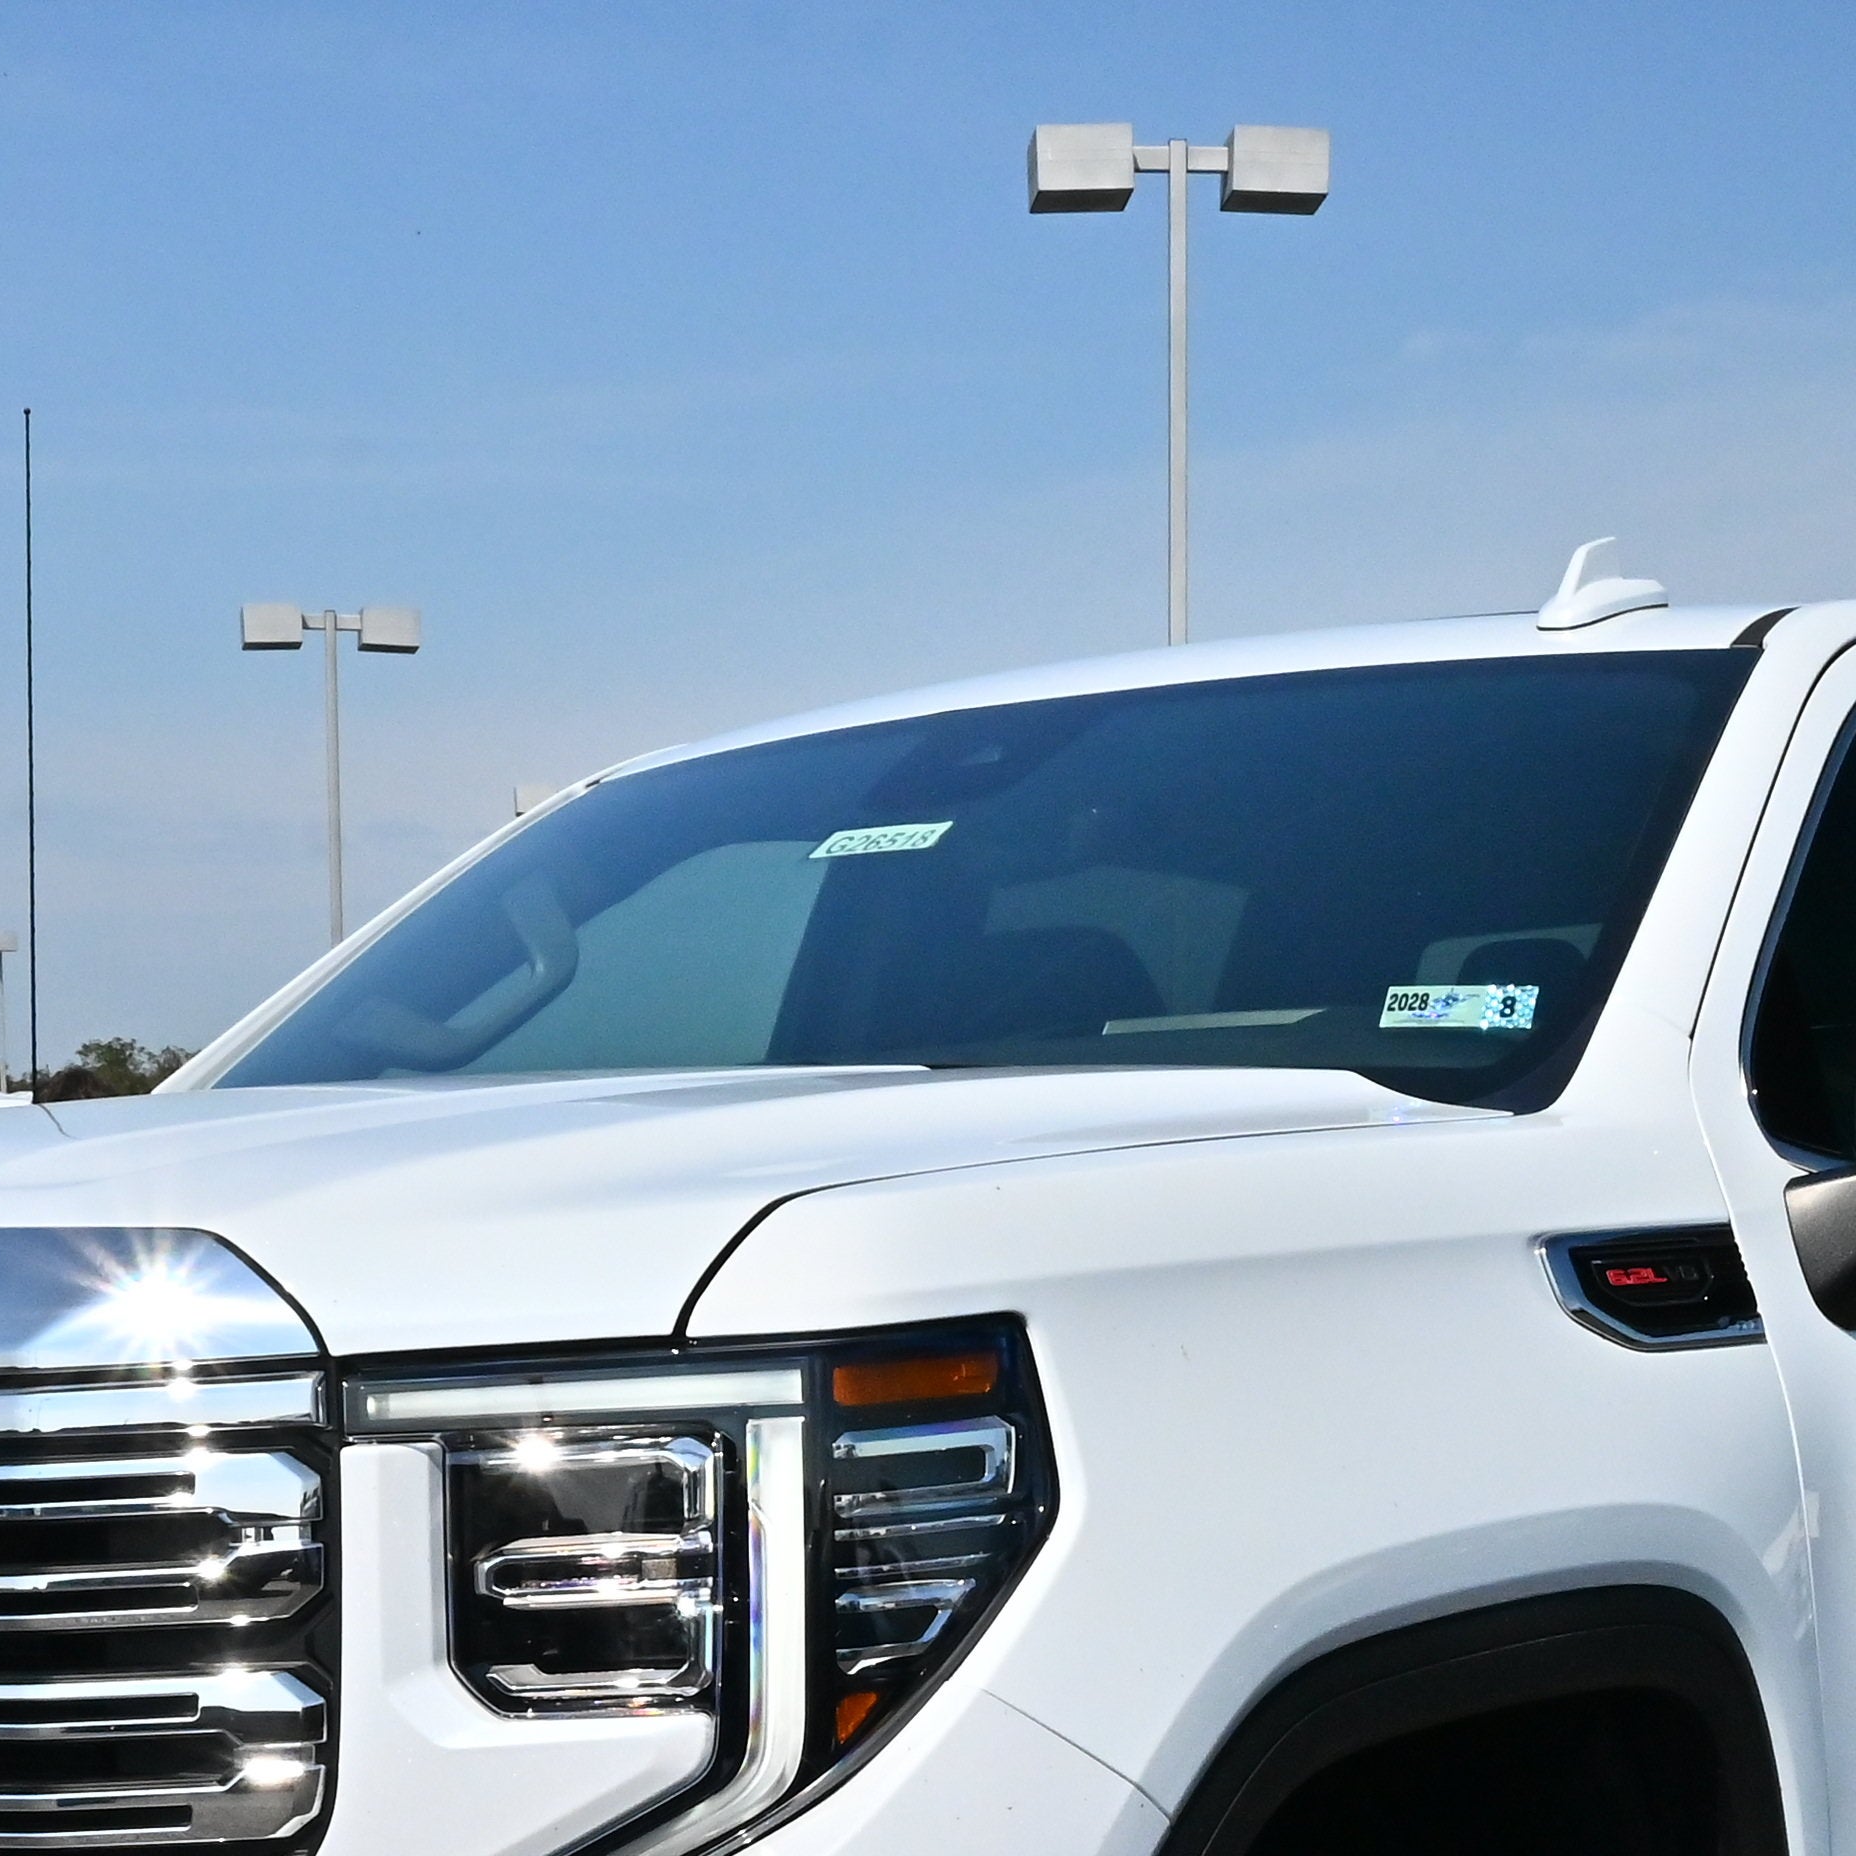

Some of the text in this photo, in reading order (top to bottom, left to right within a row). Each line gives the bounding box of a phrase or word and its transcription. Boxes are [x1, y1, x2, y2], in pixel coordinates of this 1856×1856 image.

[826, 829, 936, 854] G26518
[1387, 993, 1517, 1018] 2028 8
